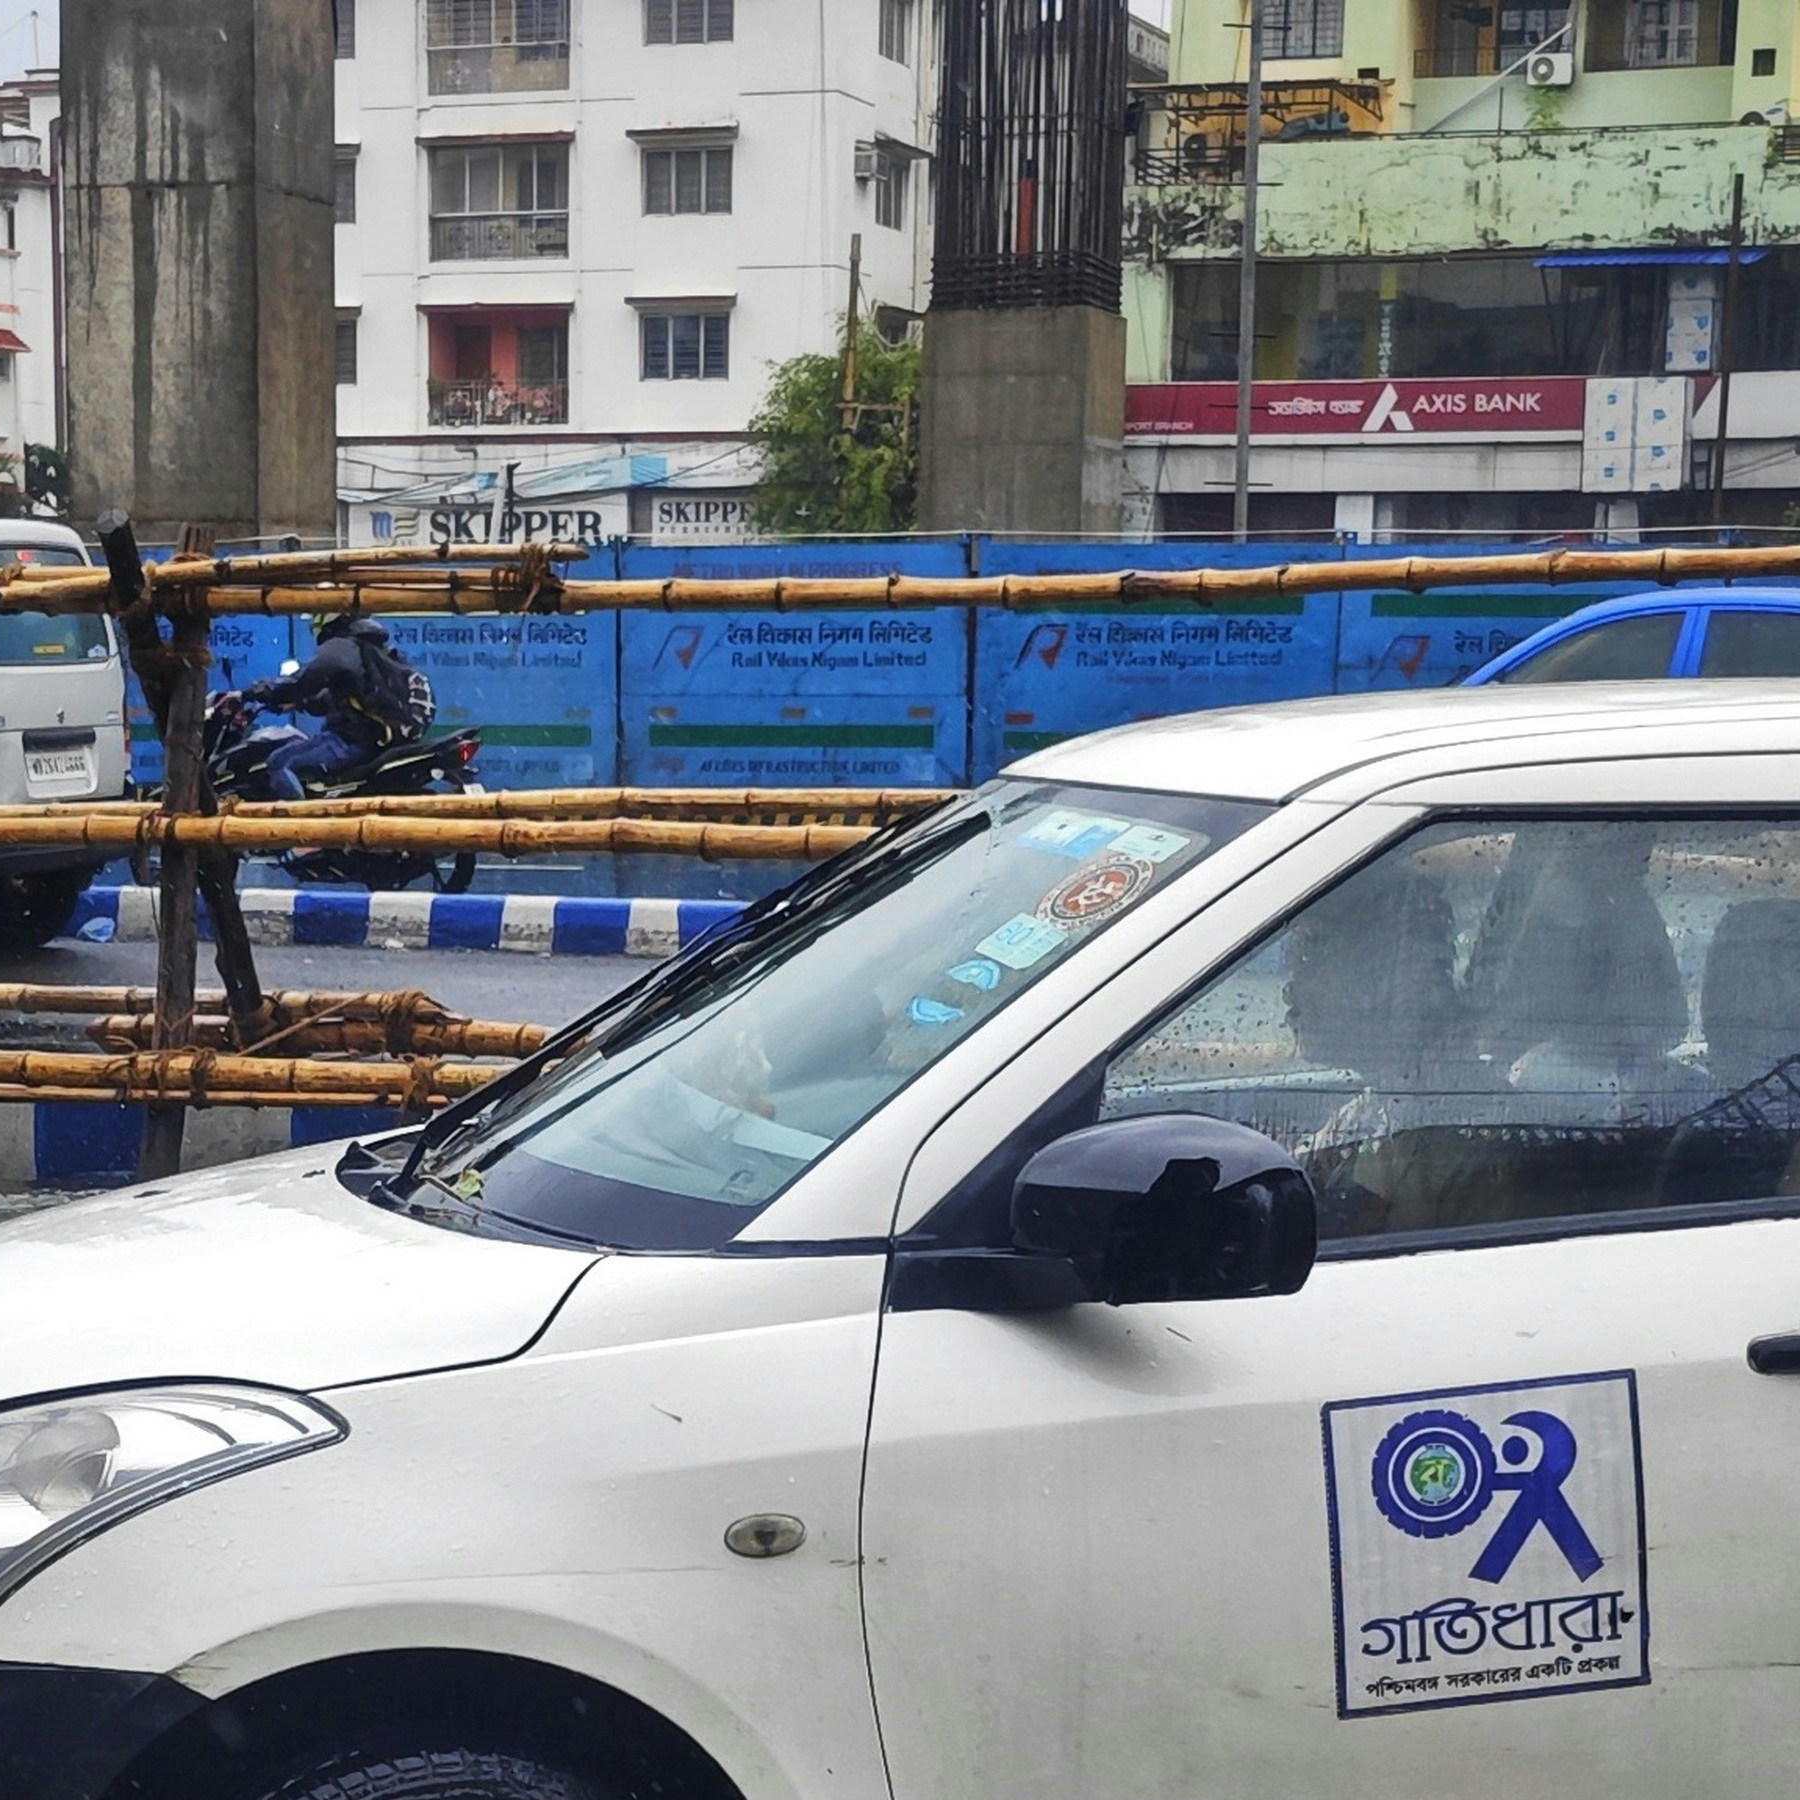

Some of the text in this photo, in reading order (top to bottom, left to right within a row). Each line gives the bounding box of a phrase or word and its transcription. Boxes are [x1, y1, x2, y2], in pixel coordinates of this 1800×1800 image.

[1412, 393, 1542, 414] AXIS BANK
[430, 510, 602, 545] SKIPPER
[732, 651, 926, 671] Rail Vikas Nigam Limited
[1075, 652, 1107, 668] Rail
[1160, 650, 1209, 670] Nigam
[1360, 1590, 1626, 1665] গতিধারা
[1365, 1675, 1441, 1698] পশ্চিমবঙ্গ
[1444, 1666, 1522, 1689] সরকারের
[1525, 1655, 1573, 1680] একটি
